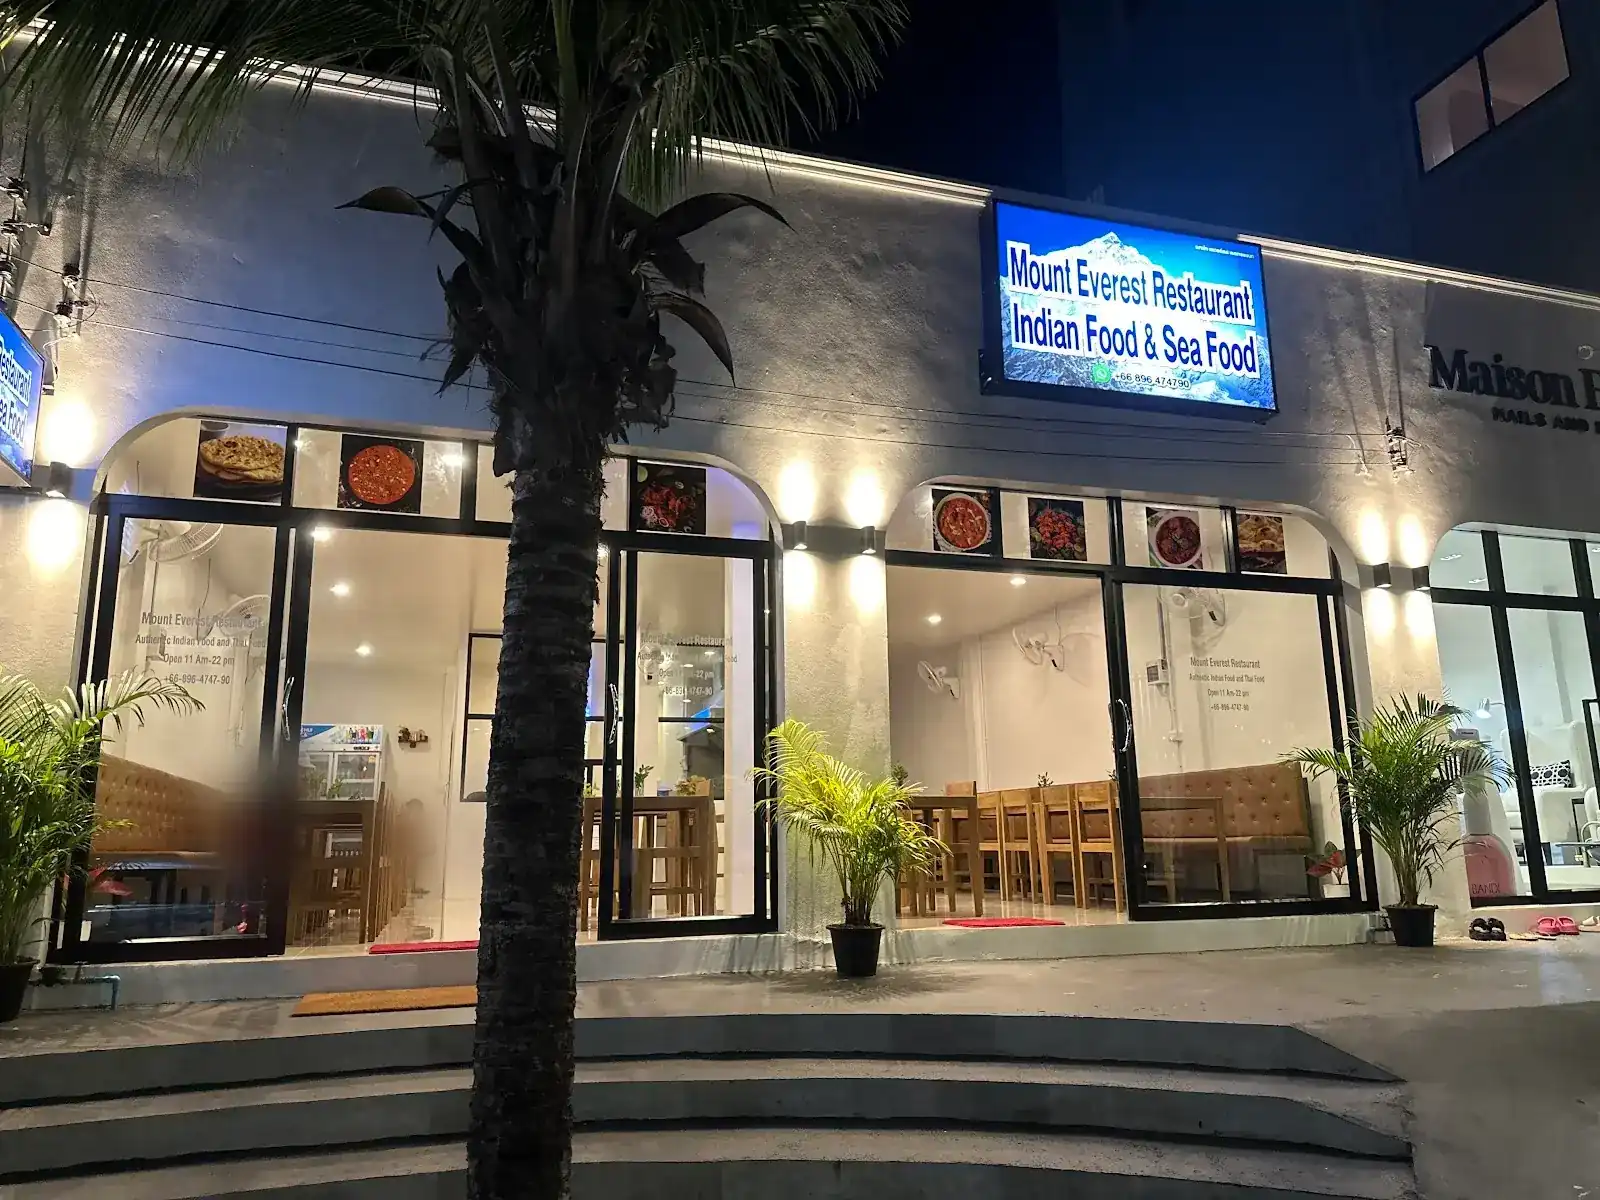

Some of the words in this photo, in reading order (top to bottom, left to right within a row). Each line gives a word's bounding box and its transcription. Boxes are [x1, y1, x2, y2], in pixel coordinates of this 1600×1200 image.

[1010, 246, 1072, 295] Mount
[1076, 258, 1148, 305] Everest
[1153, 271, 1252, 321] Restaurant
[1013, 303, 1079, 351] Indian
[1085, 314, 1137, 358] Food
[1144, 323, 1159, 361] &
[1162, 324, 1203, 367] Sea
[1206, 331, 1257, 374] Food
[0, 347, 31, 401] estaurant
[1115, 372, 1133, 382] +66
[1134, 373, 1153, 384] 896
[1155, 376, 1190, 388] 474790
[1423, 344, 1580, 408] Maison
[1491, 406, 1548, 427] NAILS
[141, 611, 172, 626] Mount
[175, 613, 210, 627] Everest
[172, 635, 196, 646] Indian
[216, 637, 230, 647] and
[164, 653, 183, 666] Open
[184, 655, 193, 664] 11
[195, 655, 221, 665] Am-22
[223, 657, 235, 667] pm
[1190, 656, 1209, 667] Mount
[1209, 657, 1231, 668] Everest
